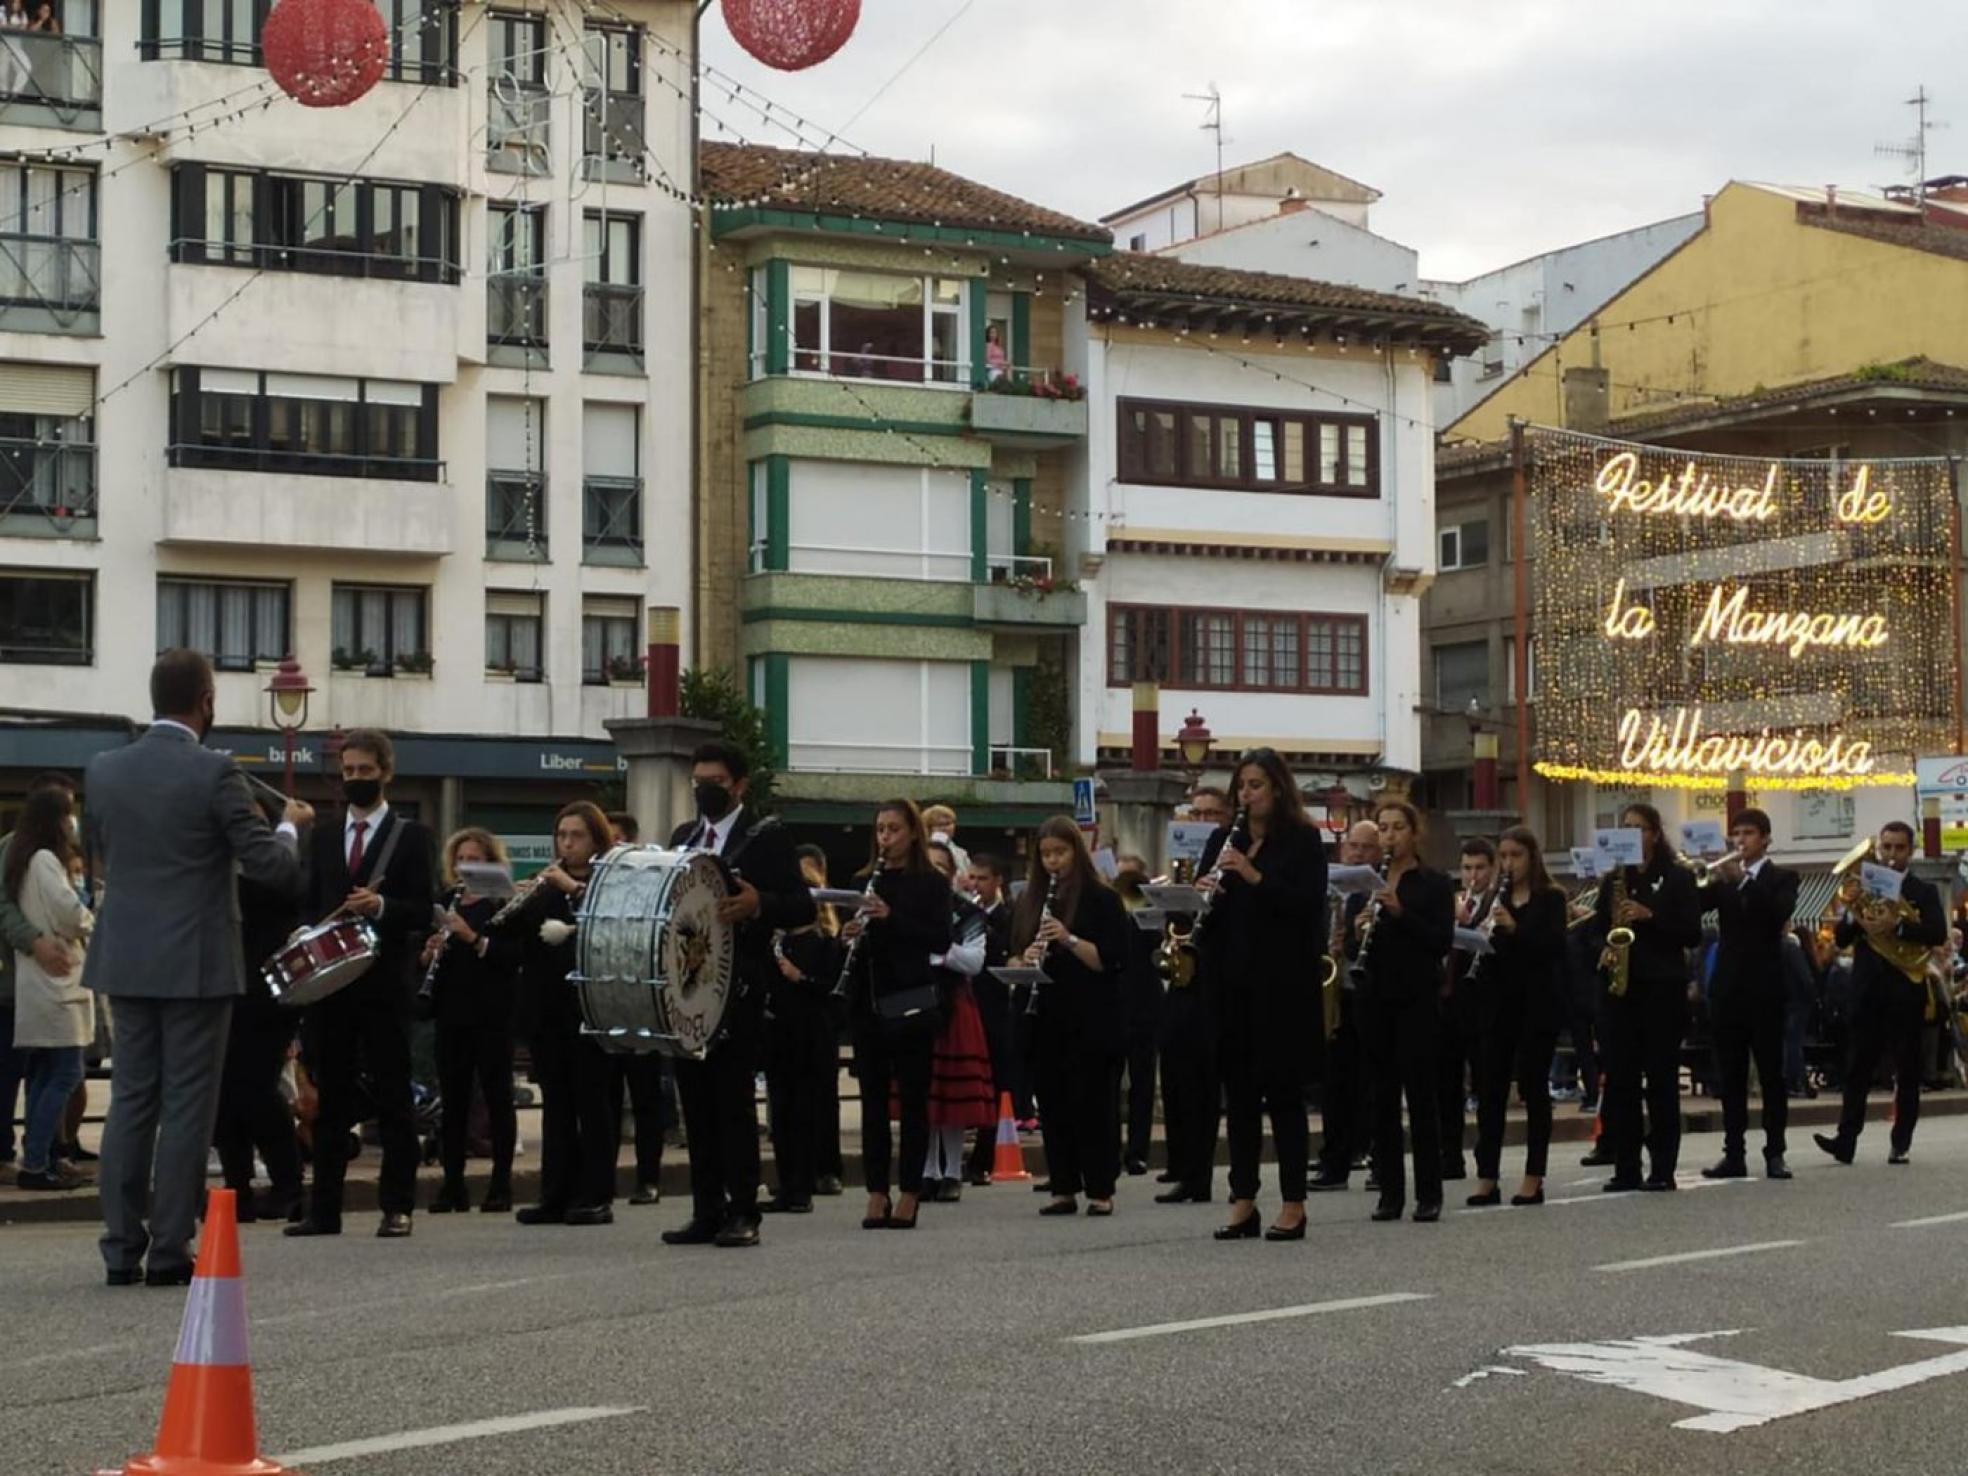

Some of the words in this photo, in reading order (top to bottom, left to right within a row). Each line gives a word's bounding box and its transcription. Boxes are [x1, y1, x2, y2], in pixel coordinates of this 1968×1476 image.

[1597, 453, 1776, 520] Festival
[1838, 464, 1892, 521] de
[1605, 577, 1655, 638] la
[1691, 584, 1889, 658] Manzana
[541, 753, 583, 769] Liber
[1618, 708, 1874, 774] Villaviciosa
